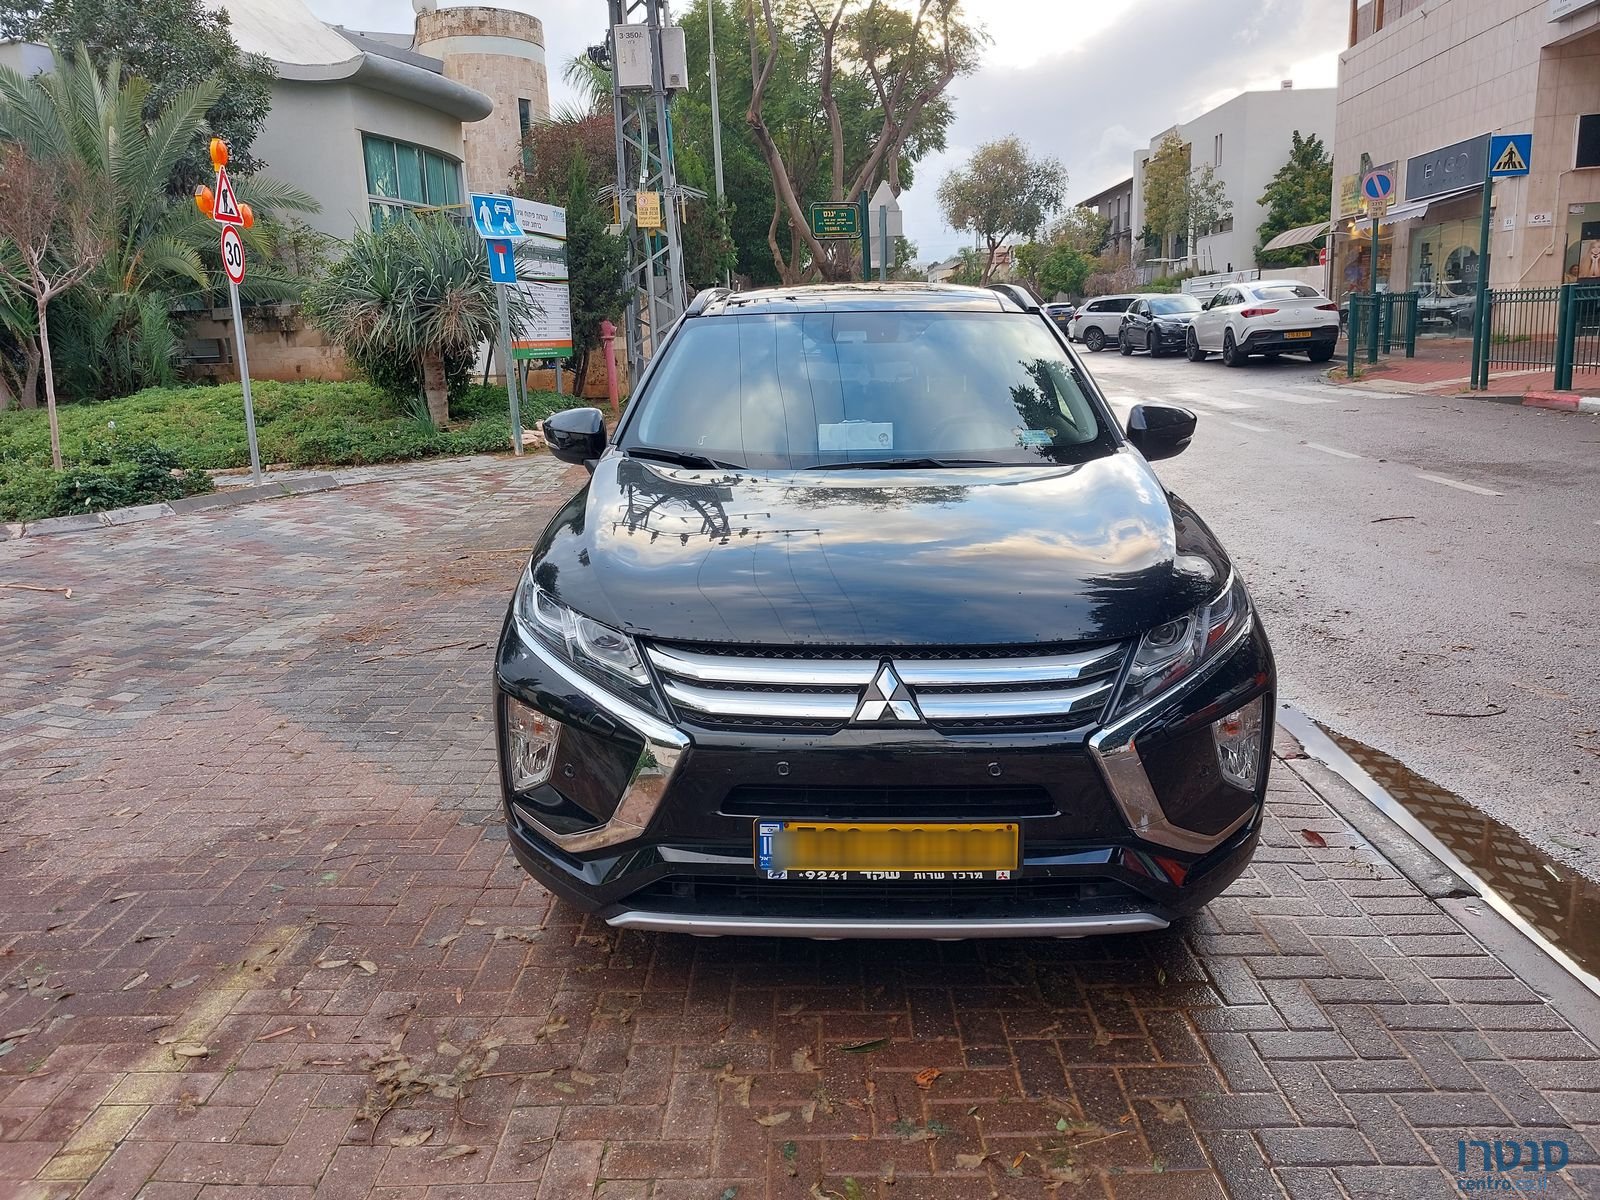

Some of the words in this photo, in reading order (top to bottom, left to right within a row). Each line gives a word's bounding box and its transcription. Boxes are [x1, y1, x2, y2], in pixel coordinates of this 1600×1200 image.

[225, 241, 242, 267] 30
[859, 871, 901, 881] שקד
[913, 871, 945, 880] שרות
[952, 871, 983, 880] מרכז
